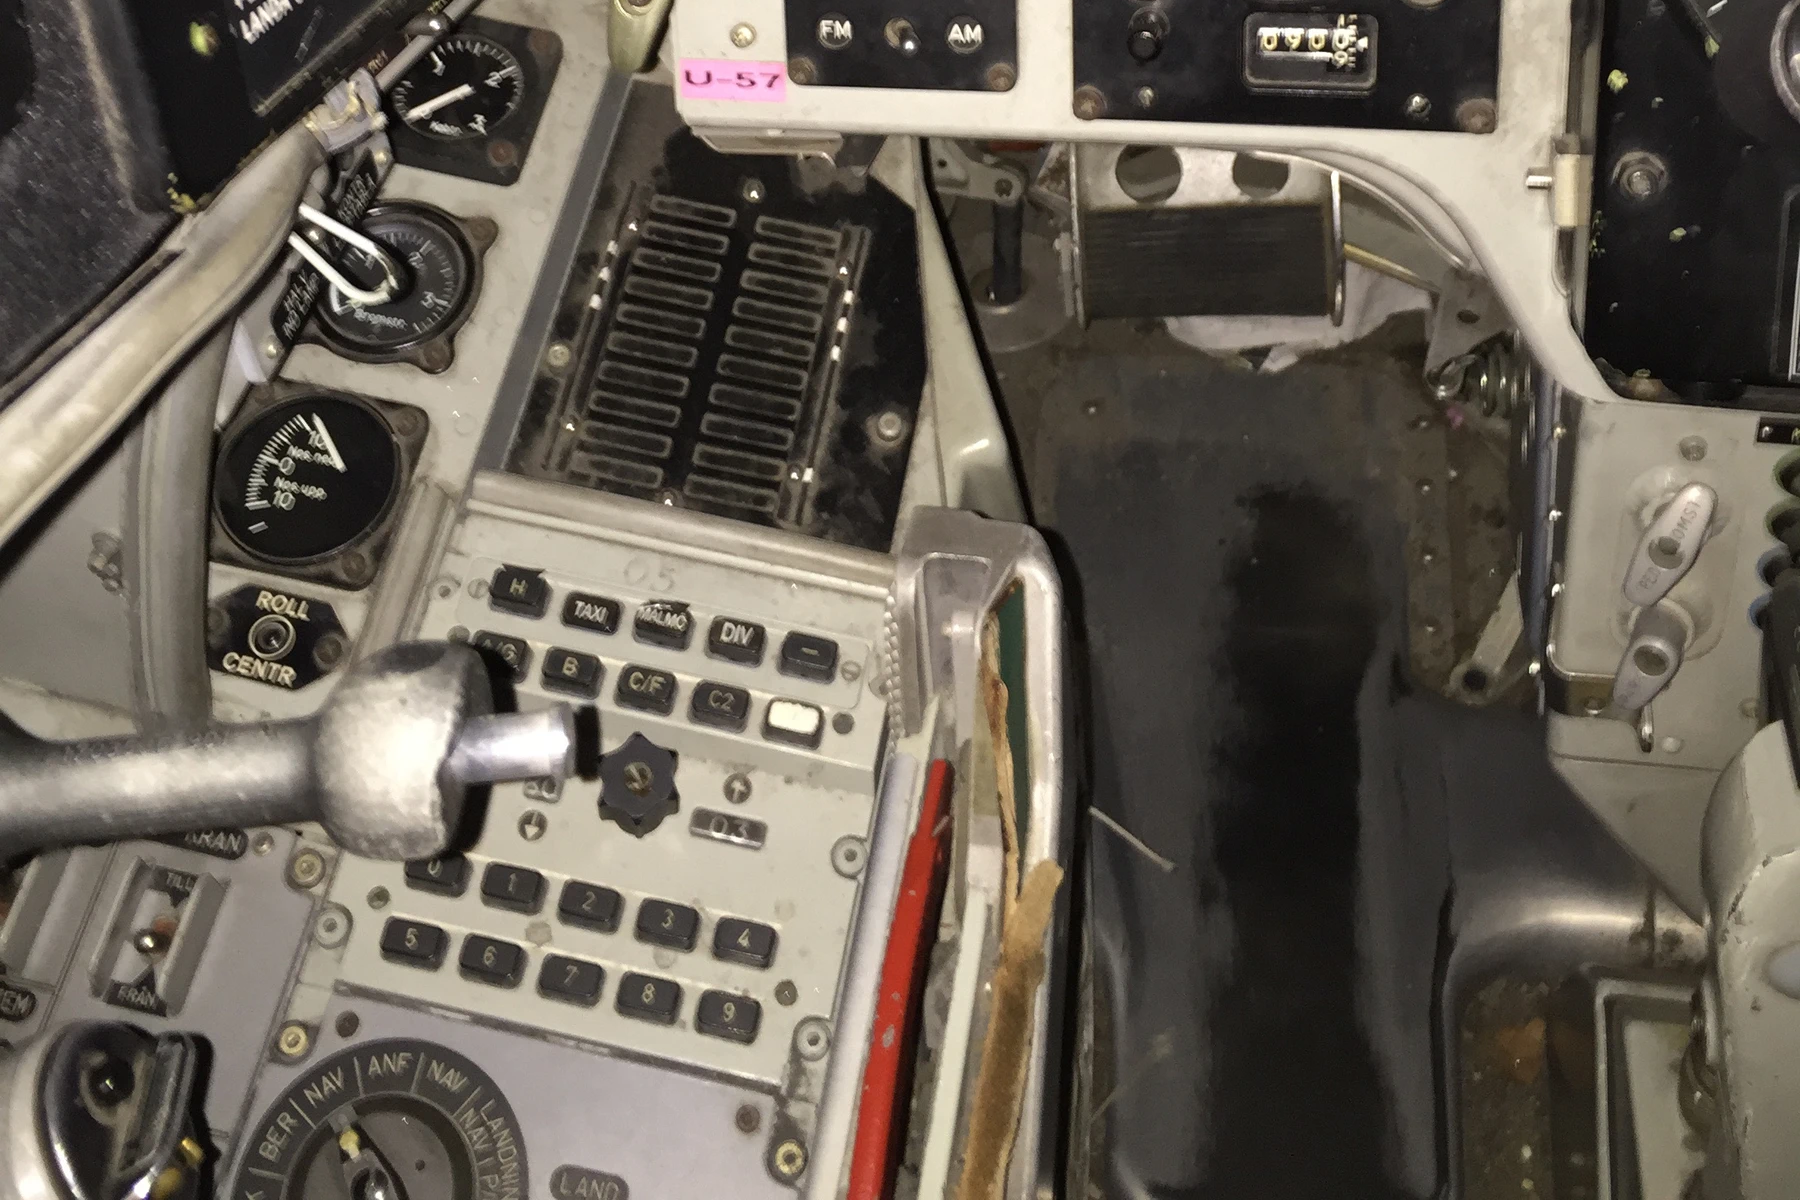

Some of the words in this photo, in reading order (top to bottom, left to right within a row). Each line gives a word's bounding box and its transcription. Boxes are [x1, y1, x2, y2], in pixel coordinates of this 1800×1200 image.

[819, 20, 852, 43] FM
[948, 23, 983, 46] AM
[684, 69, 781, 90] U-57
[279, 456, 297, 476] 0
[272, 490, 297, 511] 10
[509, 577, 527, 597] H
[255, 590, 310, 621] ROLL
[574, 600, 609, 625] TAXI
[719, 621, 754, 647] DIV
[222, 652, 297, 688] CENTR
[562, 656, 580, 678] B
[627, 671, 668, 696] C/F
[709, 689, 736, 711] C2
[506, 873, 519, 895] 1
[580, 892, 599, 913] 2
[659, 908, 676, 931] 3
[403, 928, 420, 951] 5
[737, 928, 752, 949] 4
[481, 946, 497, 967] 6
[563, 964, 580, 986] 7
[640, 983, 657, 1005] 8
[720, 1002, 737, 1025] 9
[367, 1052, 413, 1078] ANF
[427, 1059, 470, 1094] NAV
[303, 1066, 346, 1108] NAV
[258, 1110, 299, 1163] BER
[459, 1107, 493, 1151] NAV
